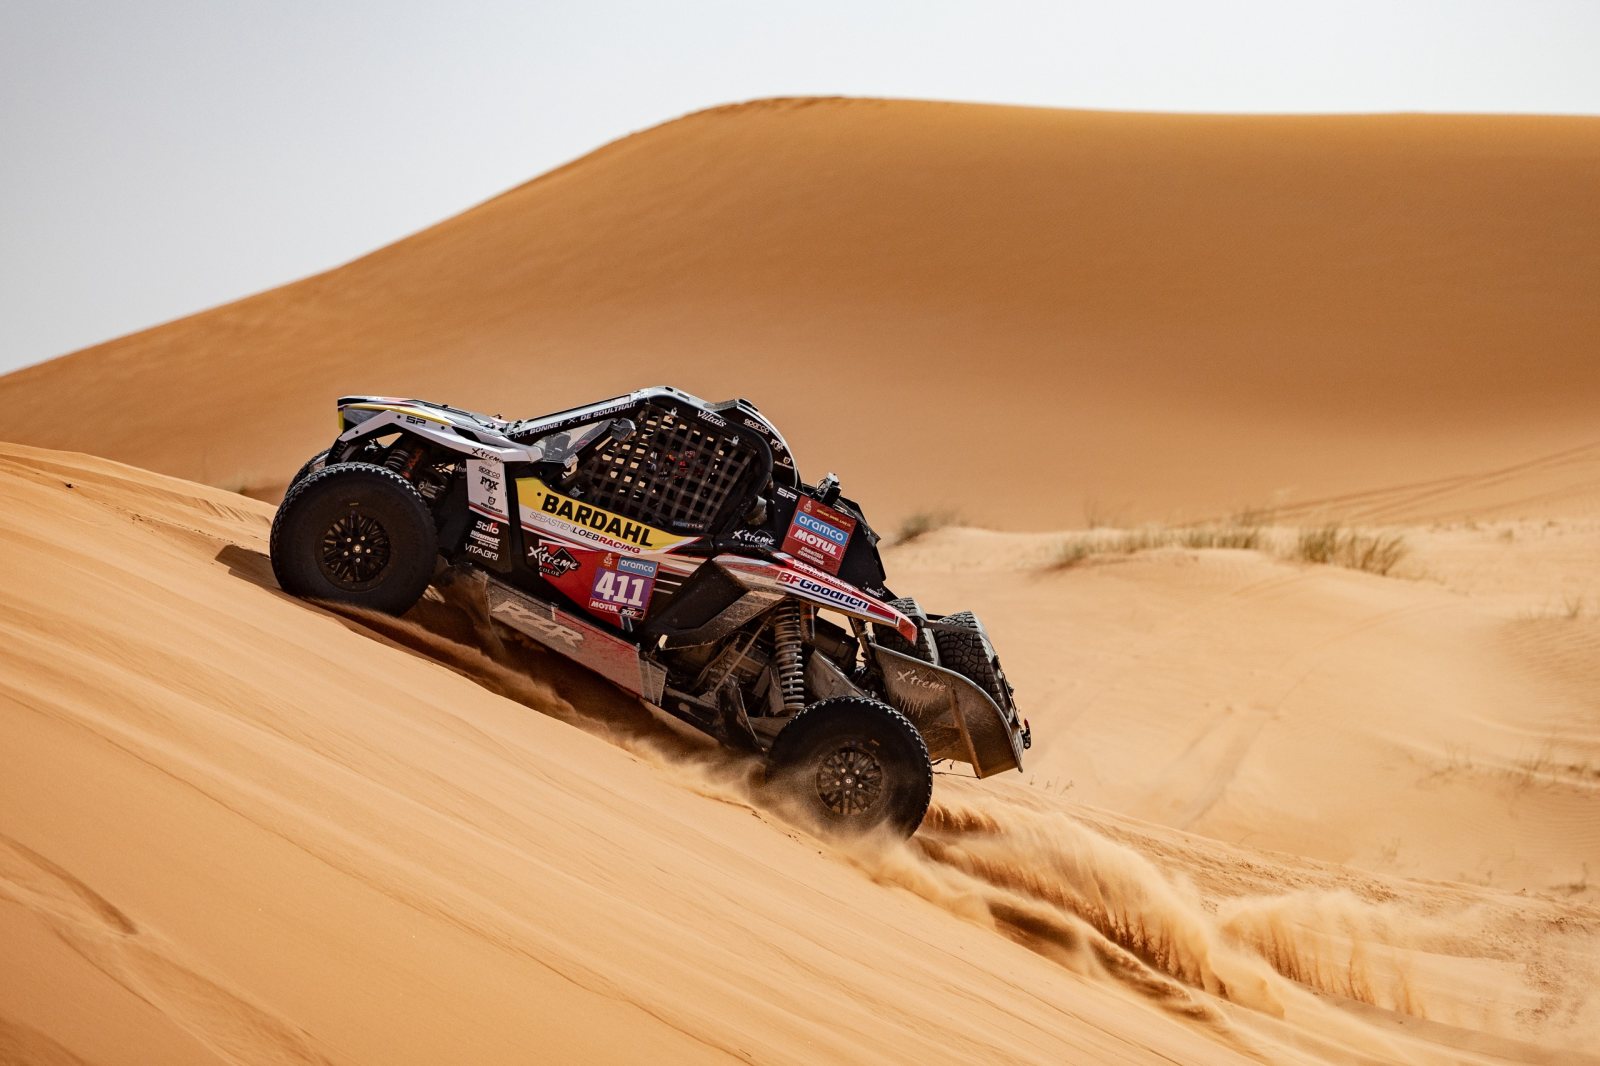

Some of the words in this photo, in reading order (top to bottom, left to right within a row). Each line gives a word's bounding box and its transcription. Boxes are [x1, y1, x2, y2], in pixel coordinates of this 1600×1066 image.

[406, 415, 426, 426] SP
[529, 420, 563, 435] BONNET
[580, 413, 592, 421] DE
[593, 400, 637, 418] SOULTRAIT
[480, 475, 499, 490] FOX
[777, 487, 798, 501] SP
[541, 493, 653, 547] BARDAHL
[799, 515, 844, 541] aramco
[465, 542, 499, 561] VITABRI
[794, 528, 837, 556] MOTUL
[538, 566, 560, 577] COLOR
[620, 558, 655, 573] aramco
[595, 570, 645, 607] 411
[779, 572, 869, 609] BFGoodrich
[590, 600, 619, 613] MOTUL
[492, 601, 585, 648] RZR
